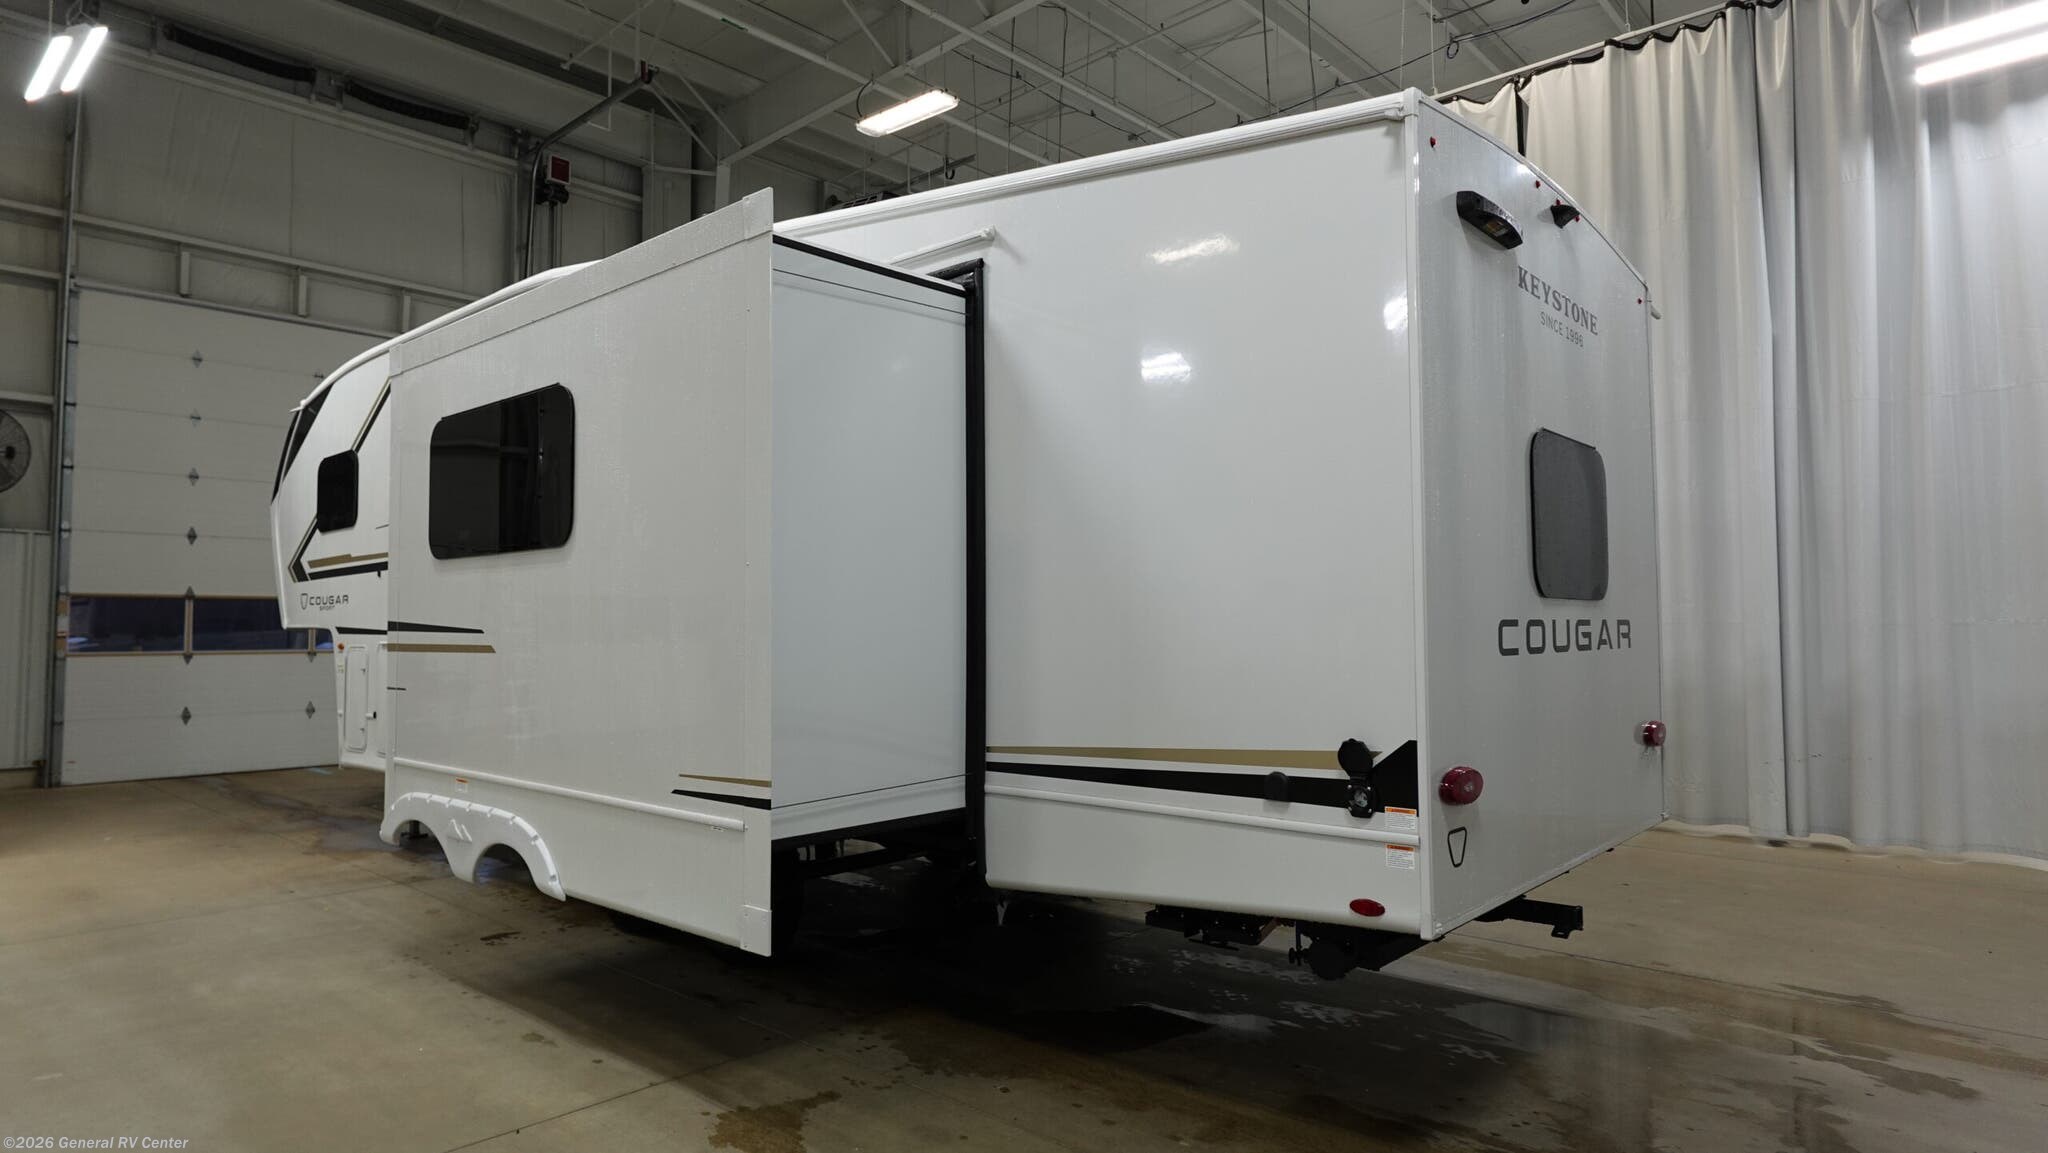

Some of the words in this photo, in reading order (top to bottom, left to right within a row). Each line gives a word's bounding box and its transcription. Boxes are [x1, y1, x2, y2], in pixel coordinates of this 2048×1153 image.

[1518, 265, 1599, 336] KEYSTONE
[1540, 311, 1563, 336] SINCE
[309, 594, 350, 606] COUGAR
[1498, 619, 1632, 656] COUGAR
